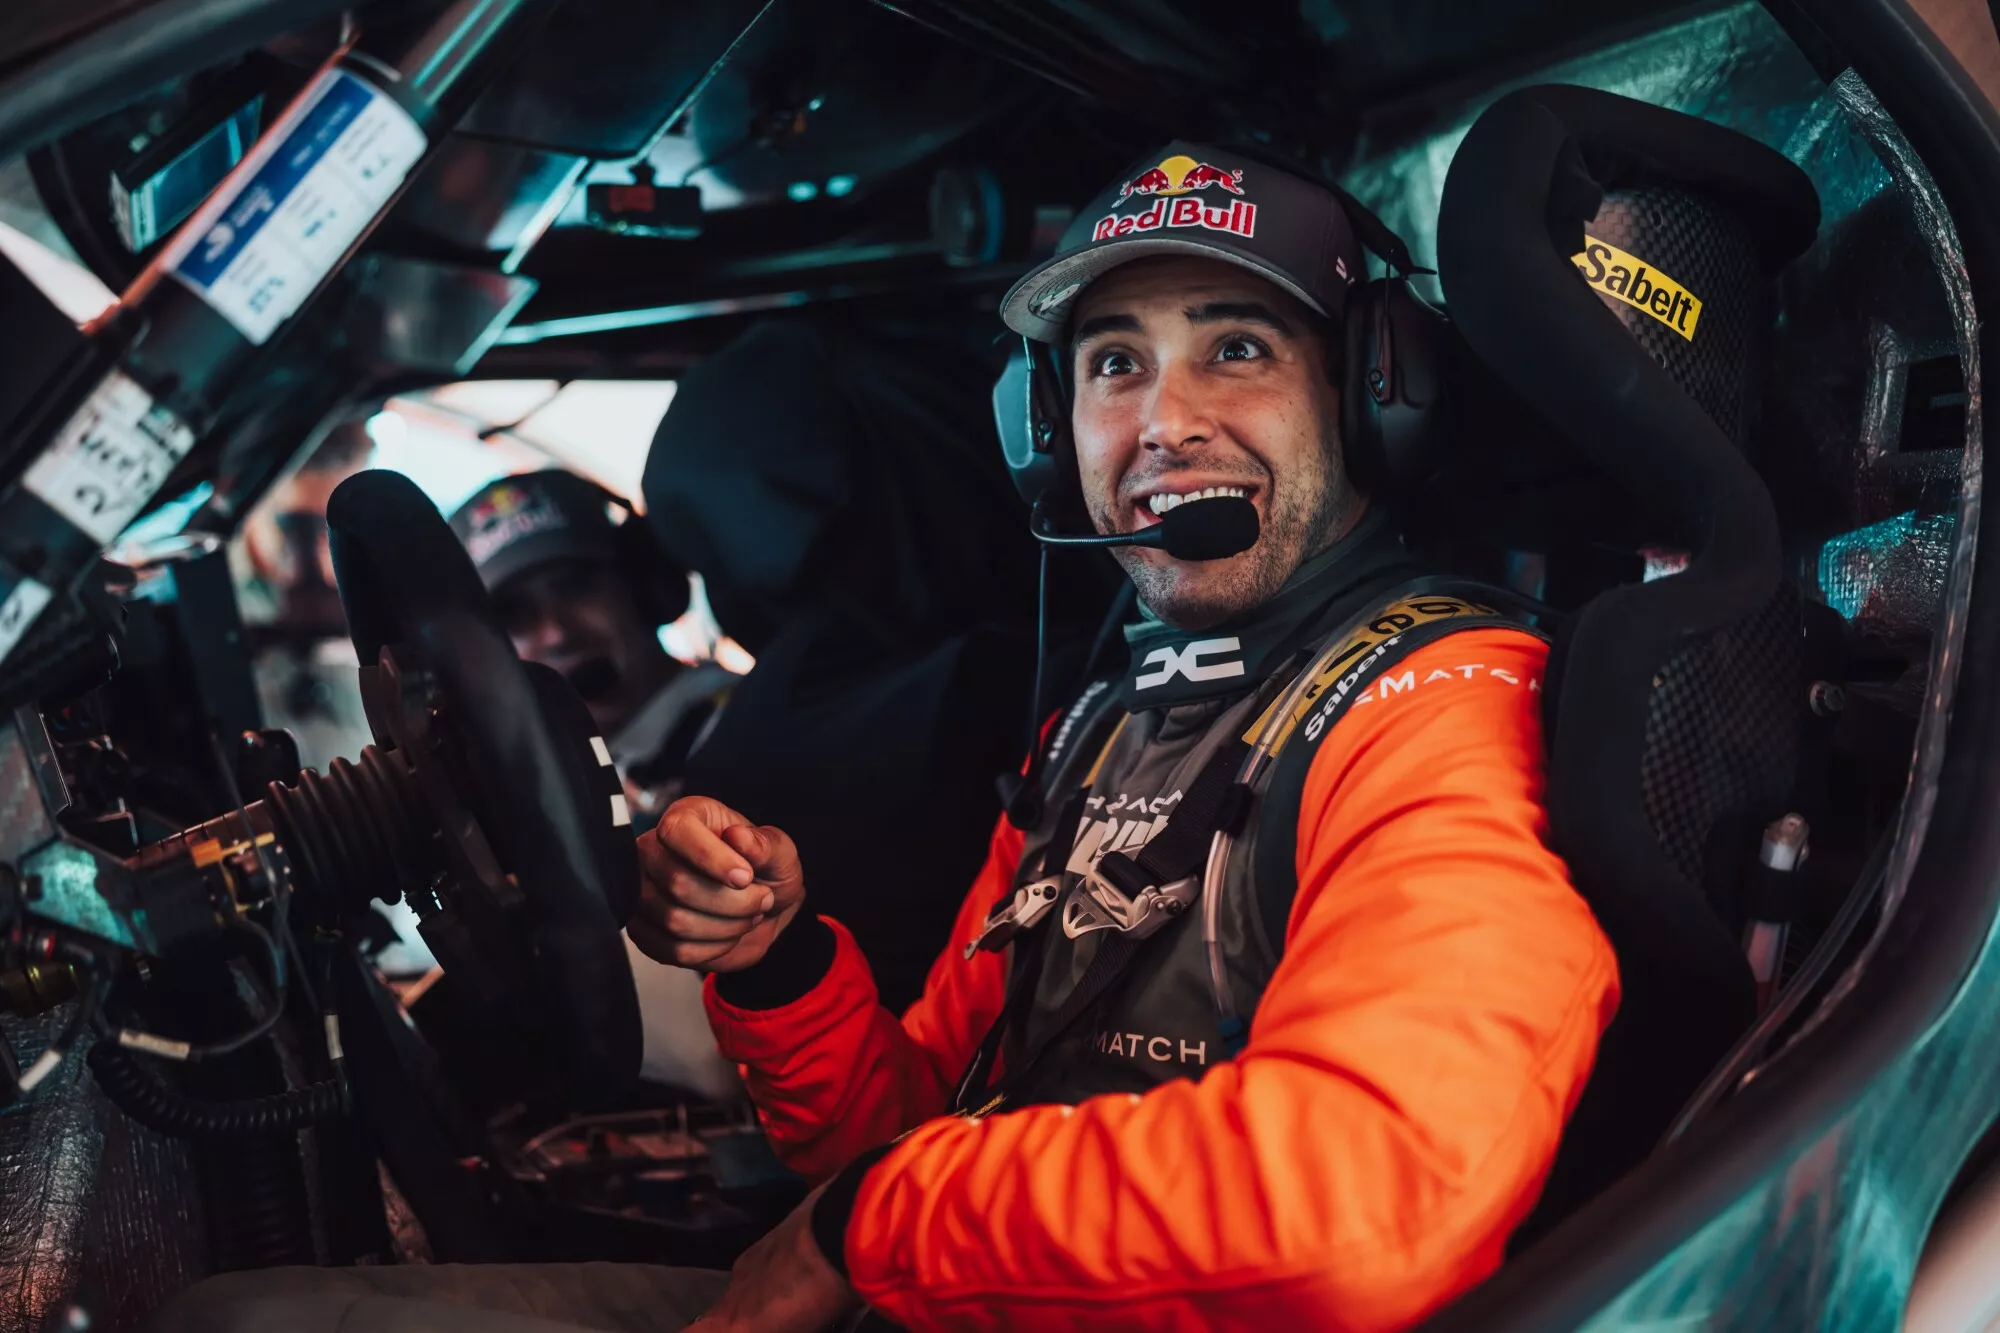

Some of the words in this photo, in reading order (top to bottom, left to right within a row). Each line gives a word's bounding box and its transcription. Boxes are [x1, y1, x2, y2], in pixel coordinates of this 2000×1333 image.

[1092, 198, 1168, 242] Red
[1169, 199, 1257, 238] Bull
[1579, 244, 1692, 331] Sabelt
[1304, 634, 1404, 742] Sabelt
